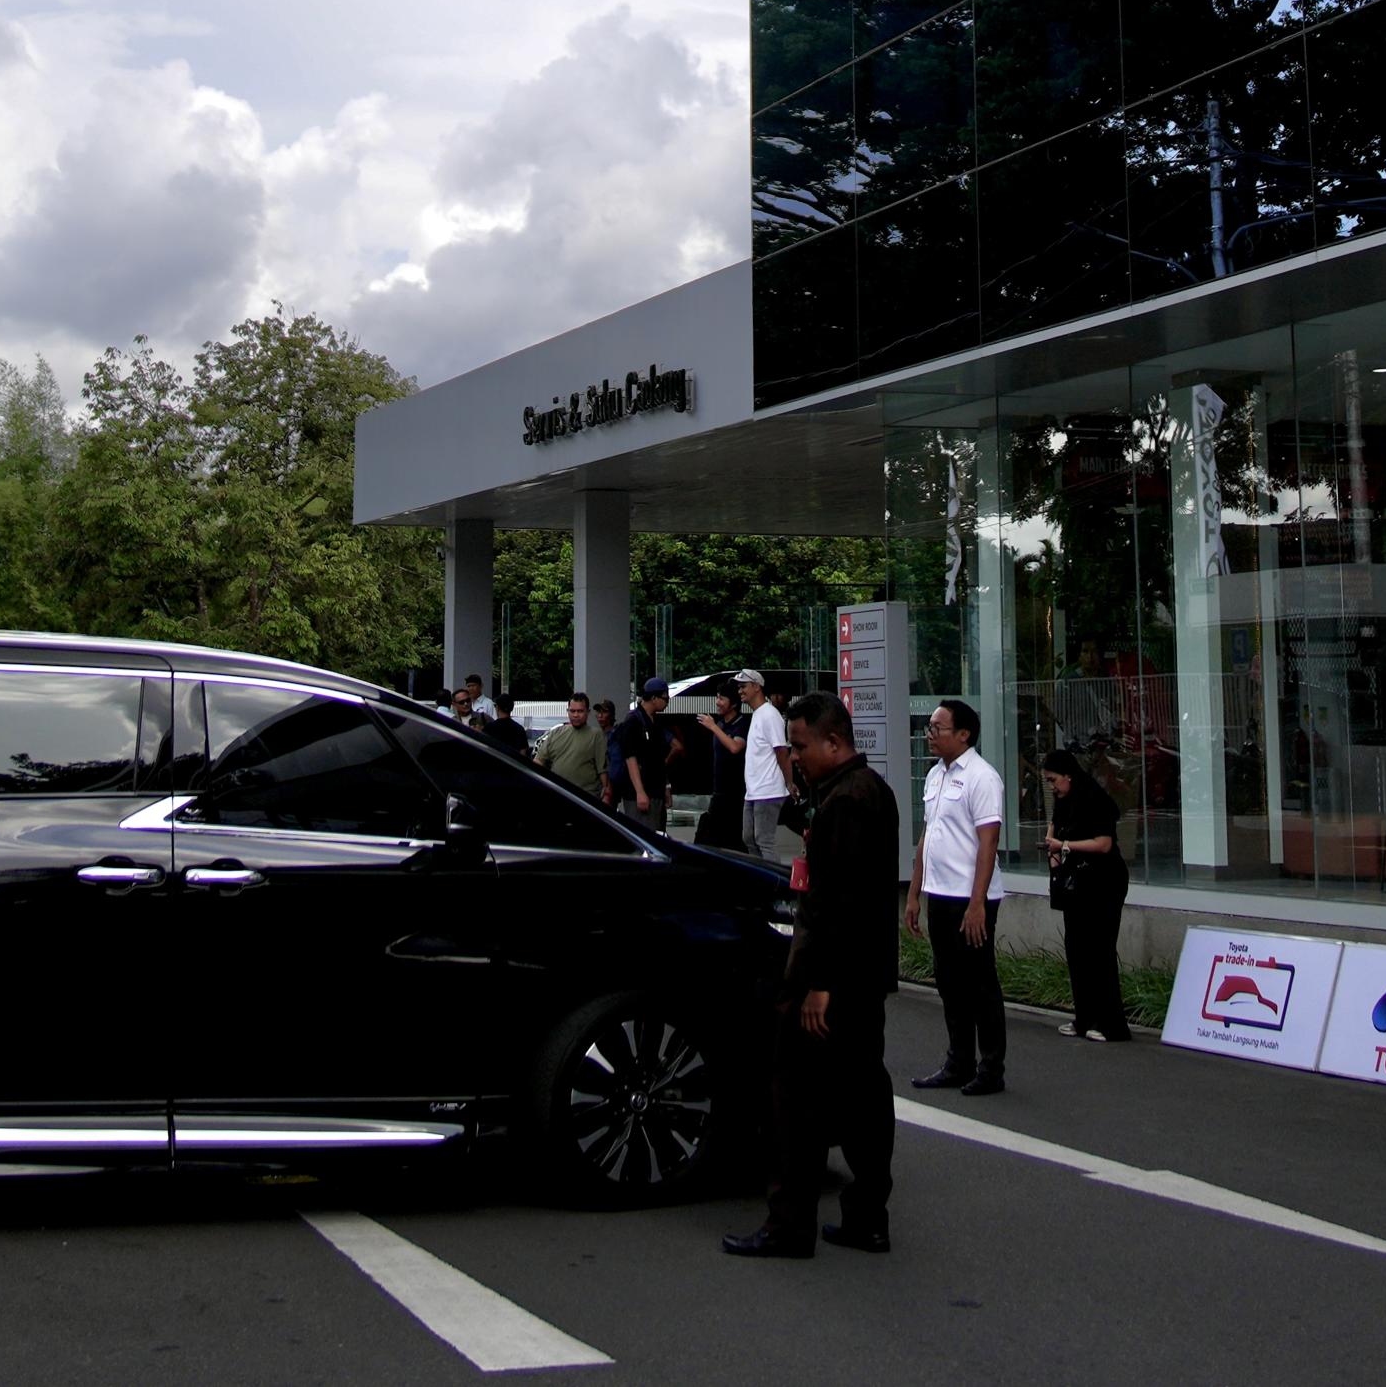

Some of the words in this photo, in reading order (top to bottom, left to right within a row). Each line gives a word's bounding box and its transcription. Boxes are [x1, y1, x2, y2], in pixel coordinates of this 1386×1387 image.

[1228, 942, 1249, 953] Toyota
[1225, 954, 1255, 966] trade-in
[1196, 1027, 1211, 1038] Tukar
[1212, 1030, 1232, 1041] Tambah
[1232, 1034, 1259, 1048] Langsung
[1259, 1039, 1279, 1050] Mudah
